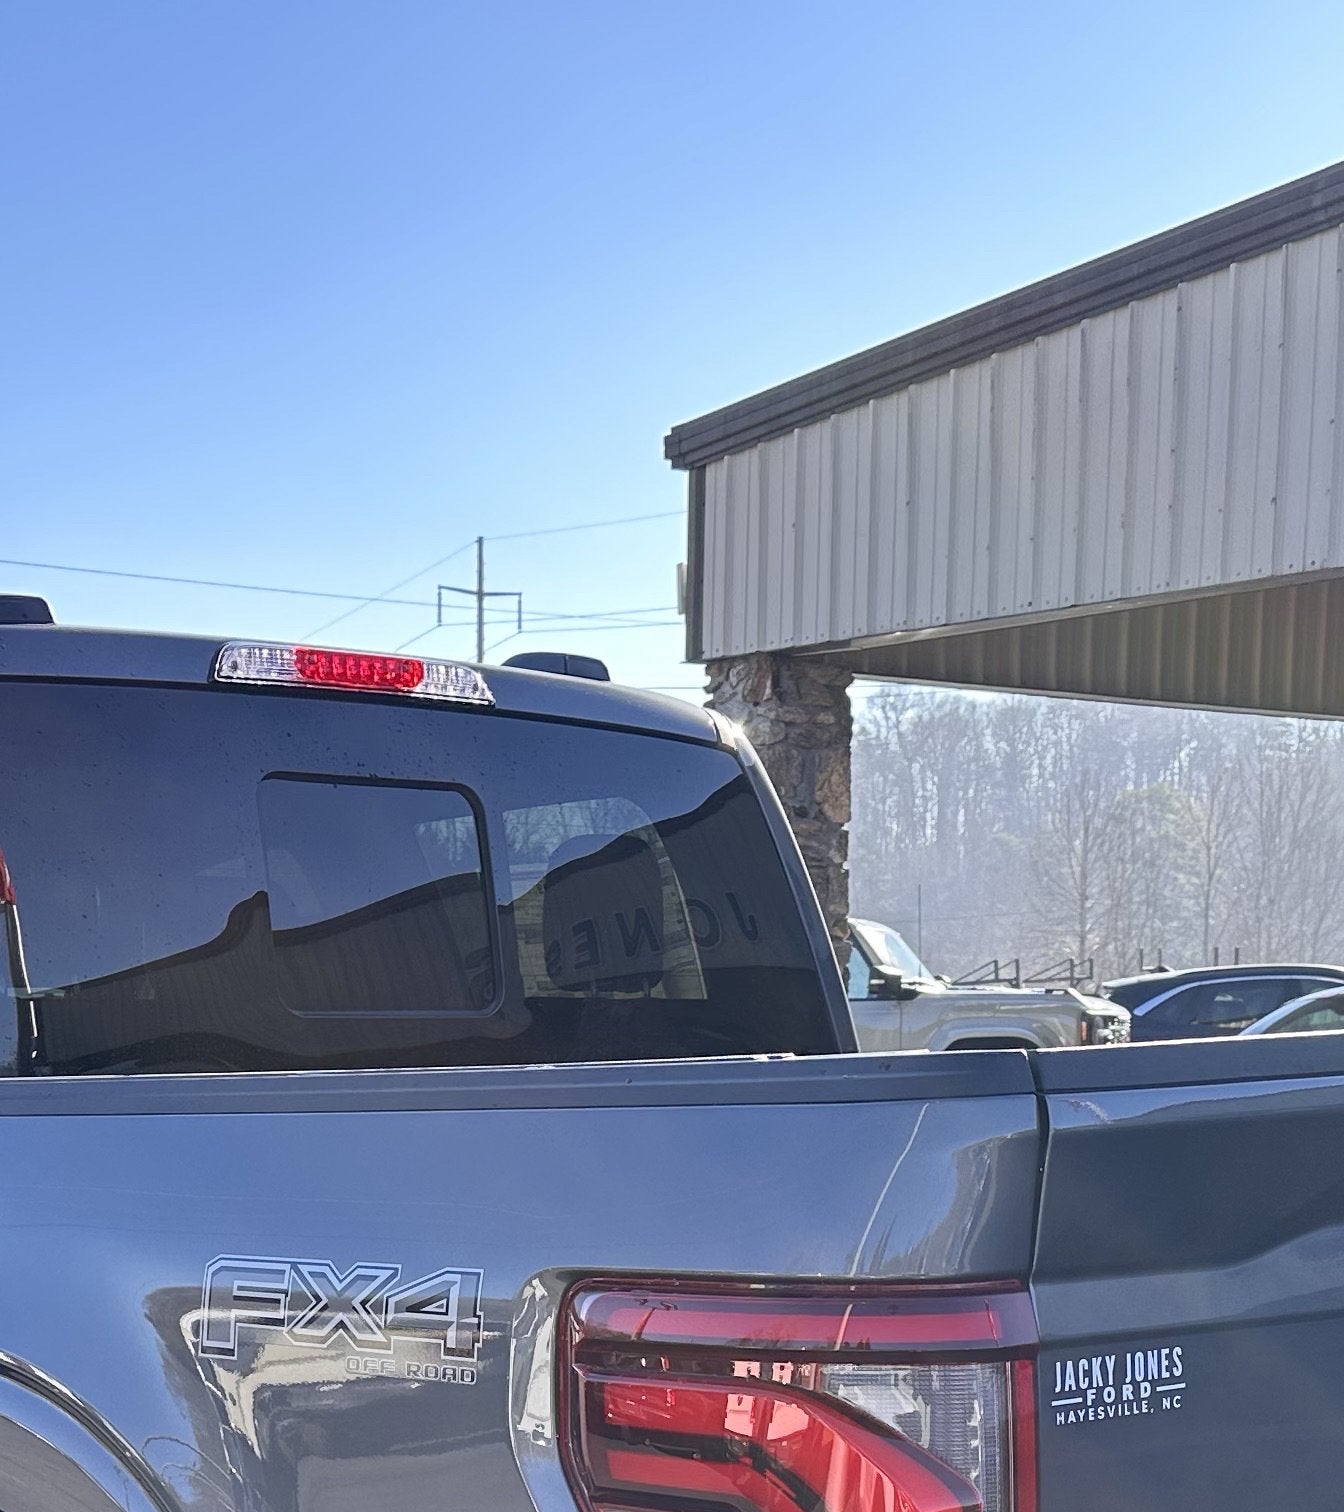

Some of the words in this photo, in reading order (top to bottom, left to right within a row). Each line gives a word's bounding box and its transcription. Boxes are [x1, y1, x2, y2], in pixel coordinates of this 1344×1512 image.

[199, 1254, 484, 1361] FX4
[345, 1355, 396, 1376] OFF
[406, 1362, 478, 1385] ROAD
[1055, 1355, 1116, 1393] JACKY
[1125, 1346, 1183, 1383] JONES
[1086, 1381, 1152, 1406] FORD
[1056, 1400, 1154, 1426] HAYESVILLE,
[1162, 1395, 1182, 1410] NC
